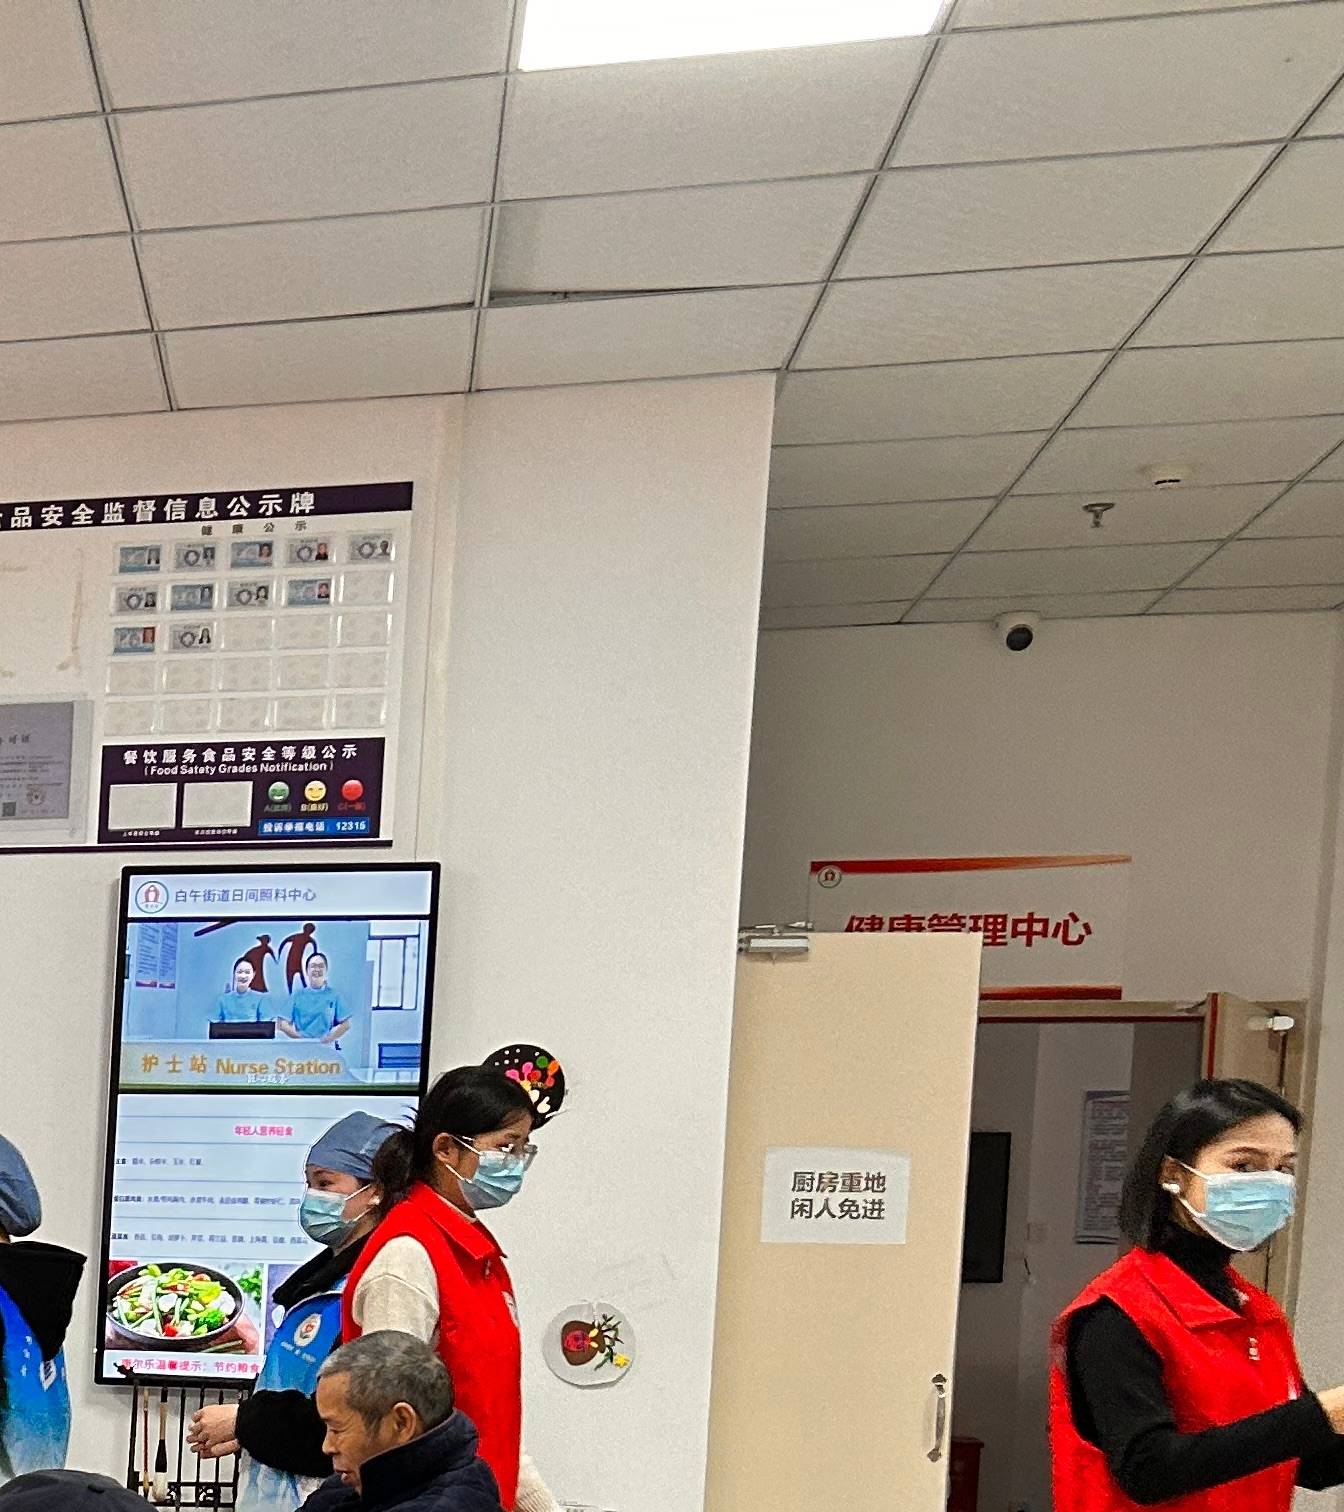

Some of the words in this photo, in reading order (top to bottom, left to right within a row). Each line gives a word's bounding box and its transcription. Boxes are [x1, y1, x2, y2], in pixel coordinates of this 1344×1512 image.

[123, 743, 358, 765] 餐饮服务食品安全等级公示
[218, 761, 258, 775] Grades
[174, 888, 317, 903] 白午街道日间照料中心
[141, 1054, 208, 1074] 护士站
[215, 1058, 269, 1075] Nurse
[274, 1057, 341, 1076] Station
[791, 1171, 886, 1194] 厨房重地
[790, 1198, 885, 1221] 闲人免进
